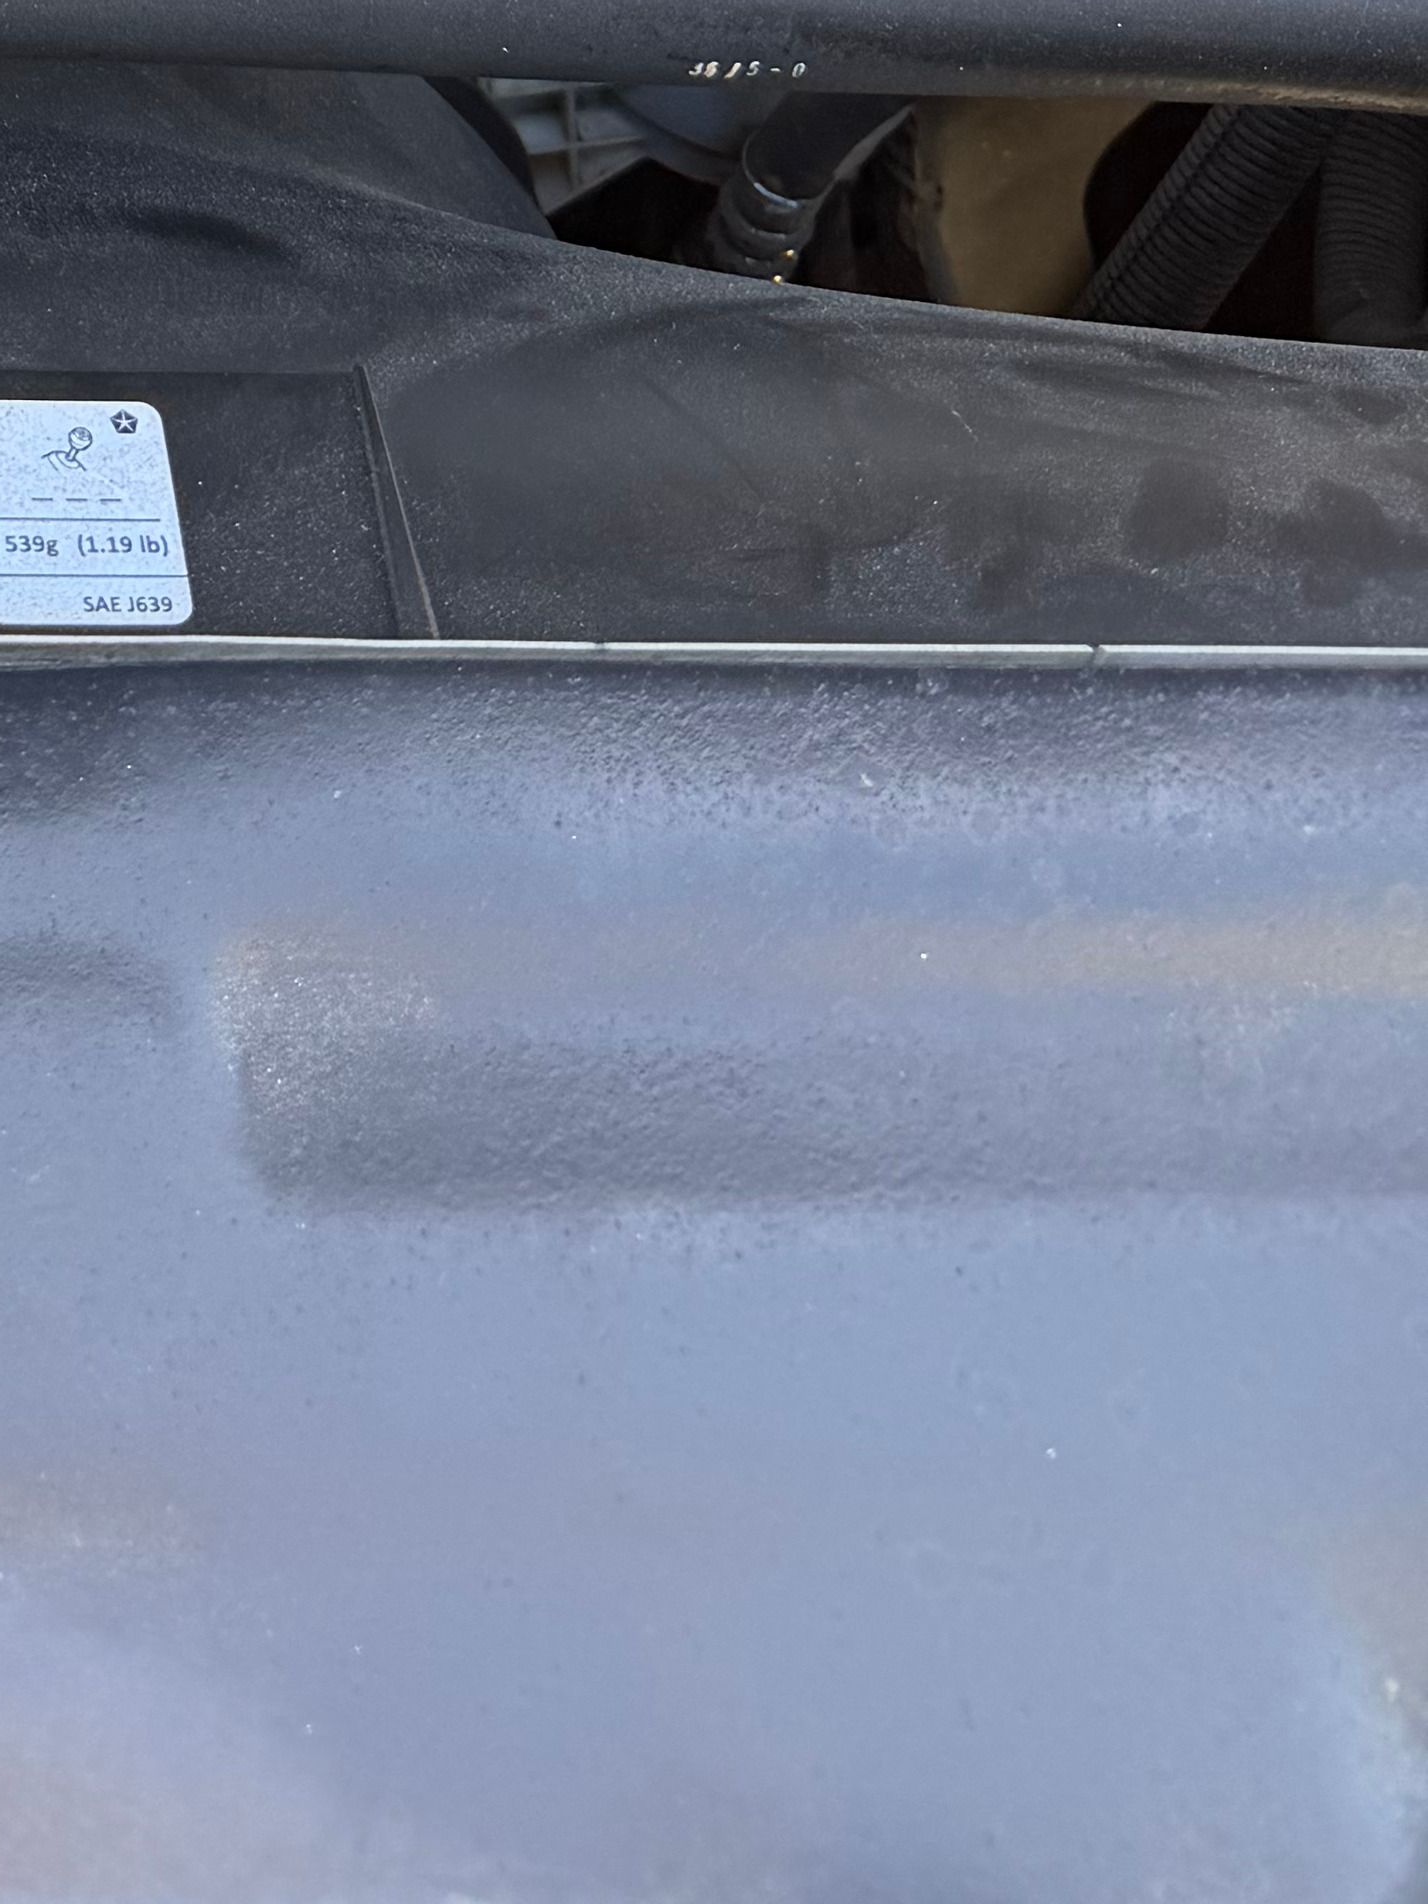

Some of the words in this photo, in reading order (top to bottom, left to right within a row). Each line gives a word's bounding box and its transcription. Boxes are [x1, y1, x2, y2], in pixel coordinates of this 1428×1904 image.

[5, 535, 59, 557] 539g
[77, 534, 132, 557] (1.19
[140, 534, 169, 557] lb)
[82, 596, 122, 613] SAE
[126, 596, 174, 613] J639
